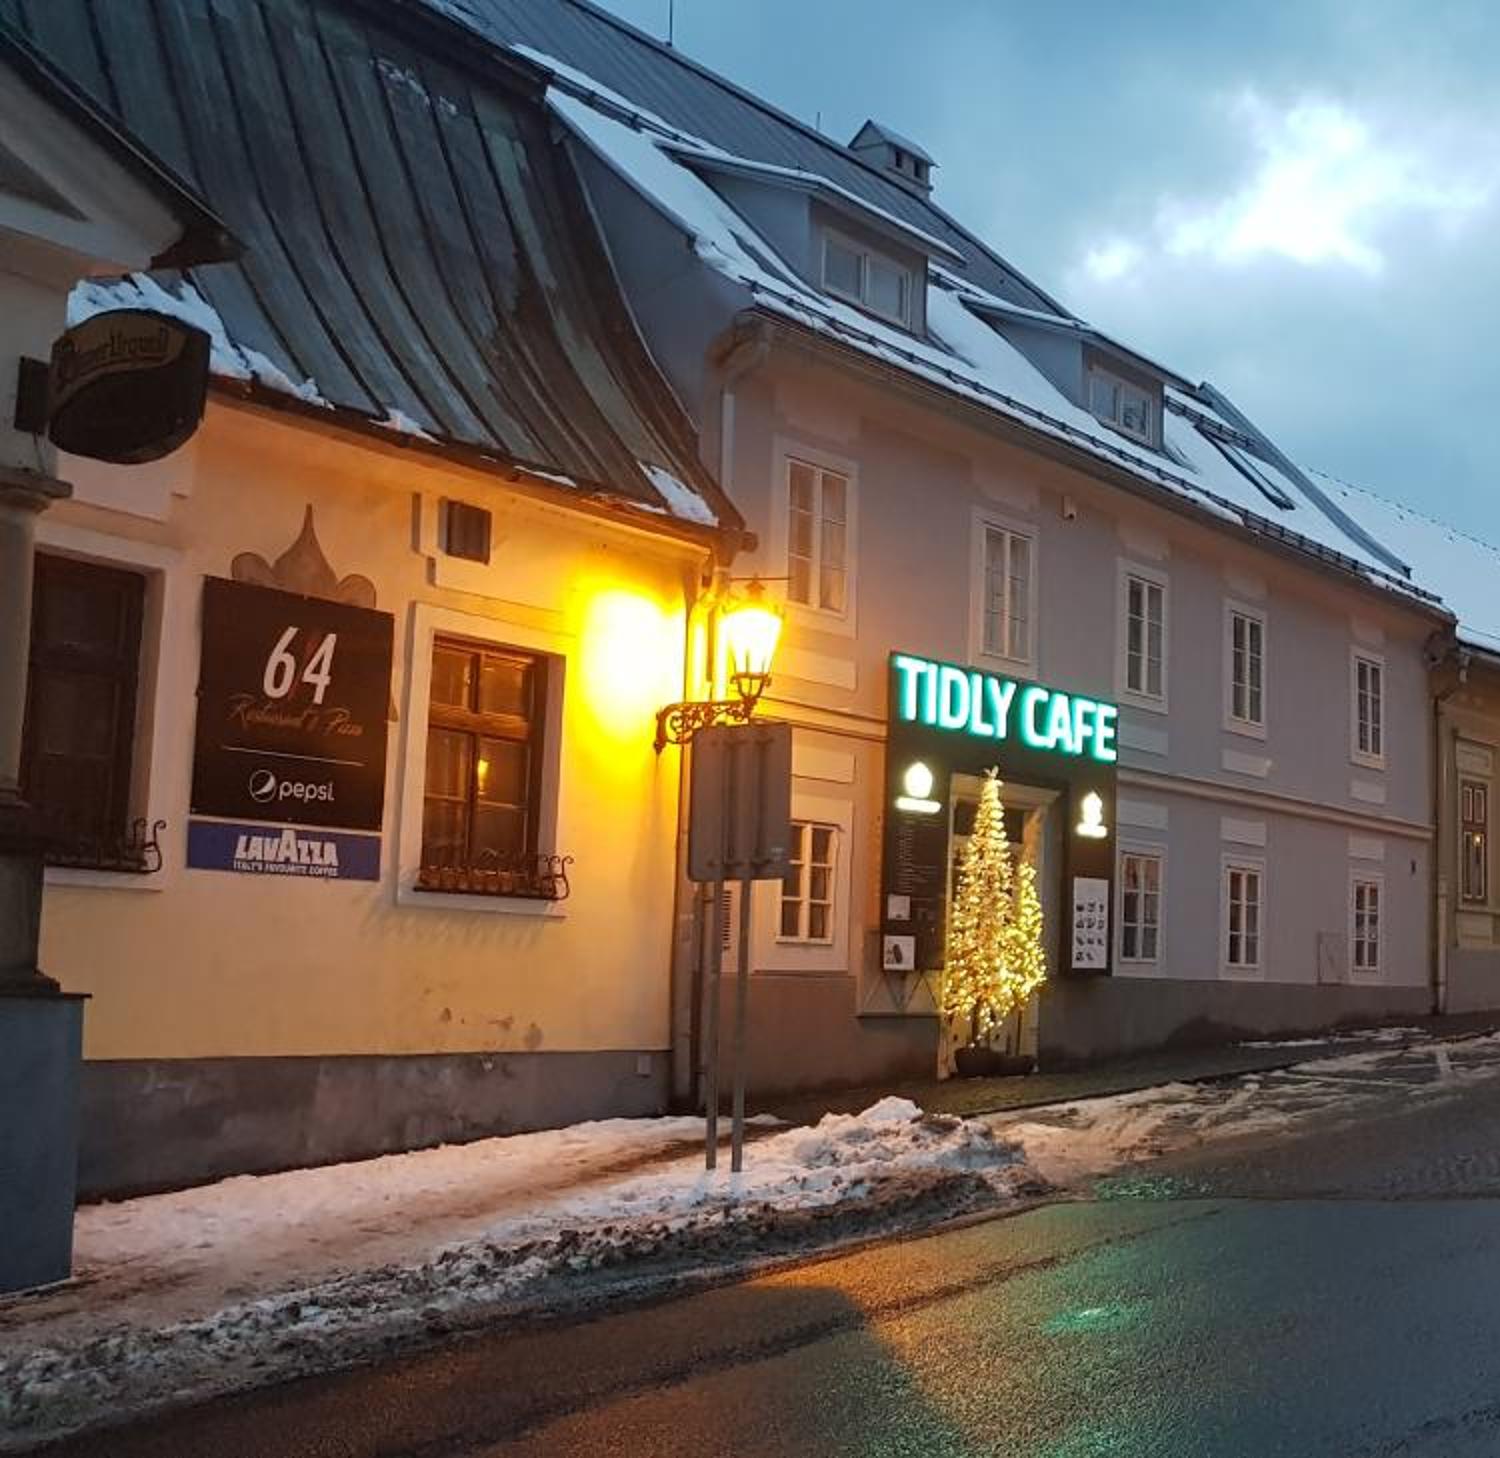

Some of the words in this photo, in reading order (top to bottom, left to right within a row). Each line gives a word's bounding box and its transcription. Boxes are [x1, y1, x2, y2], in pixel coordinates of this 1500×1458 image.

[263, 626, 337, 705] 64
[895, 655, 1017, 739] TIDLY
[1022, 686, 1118, 762] CAFE
[279, 781, 335, 803] pepsi
[234, 829, 339, 866] LAVAZZA
